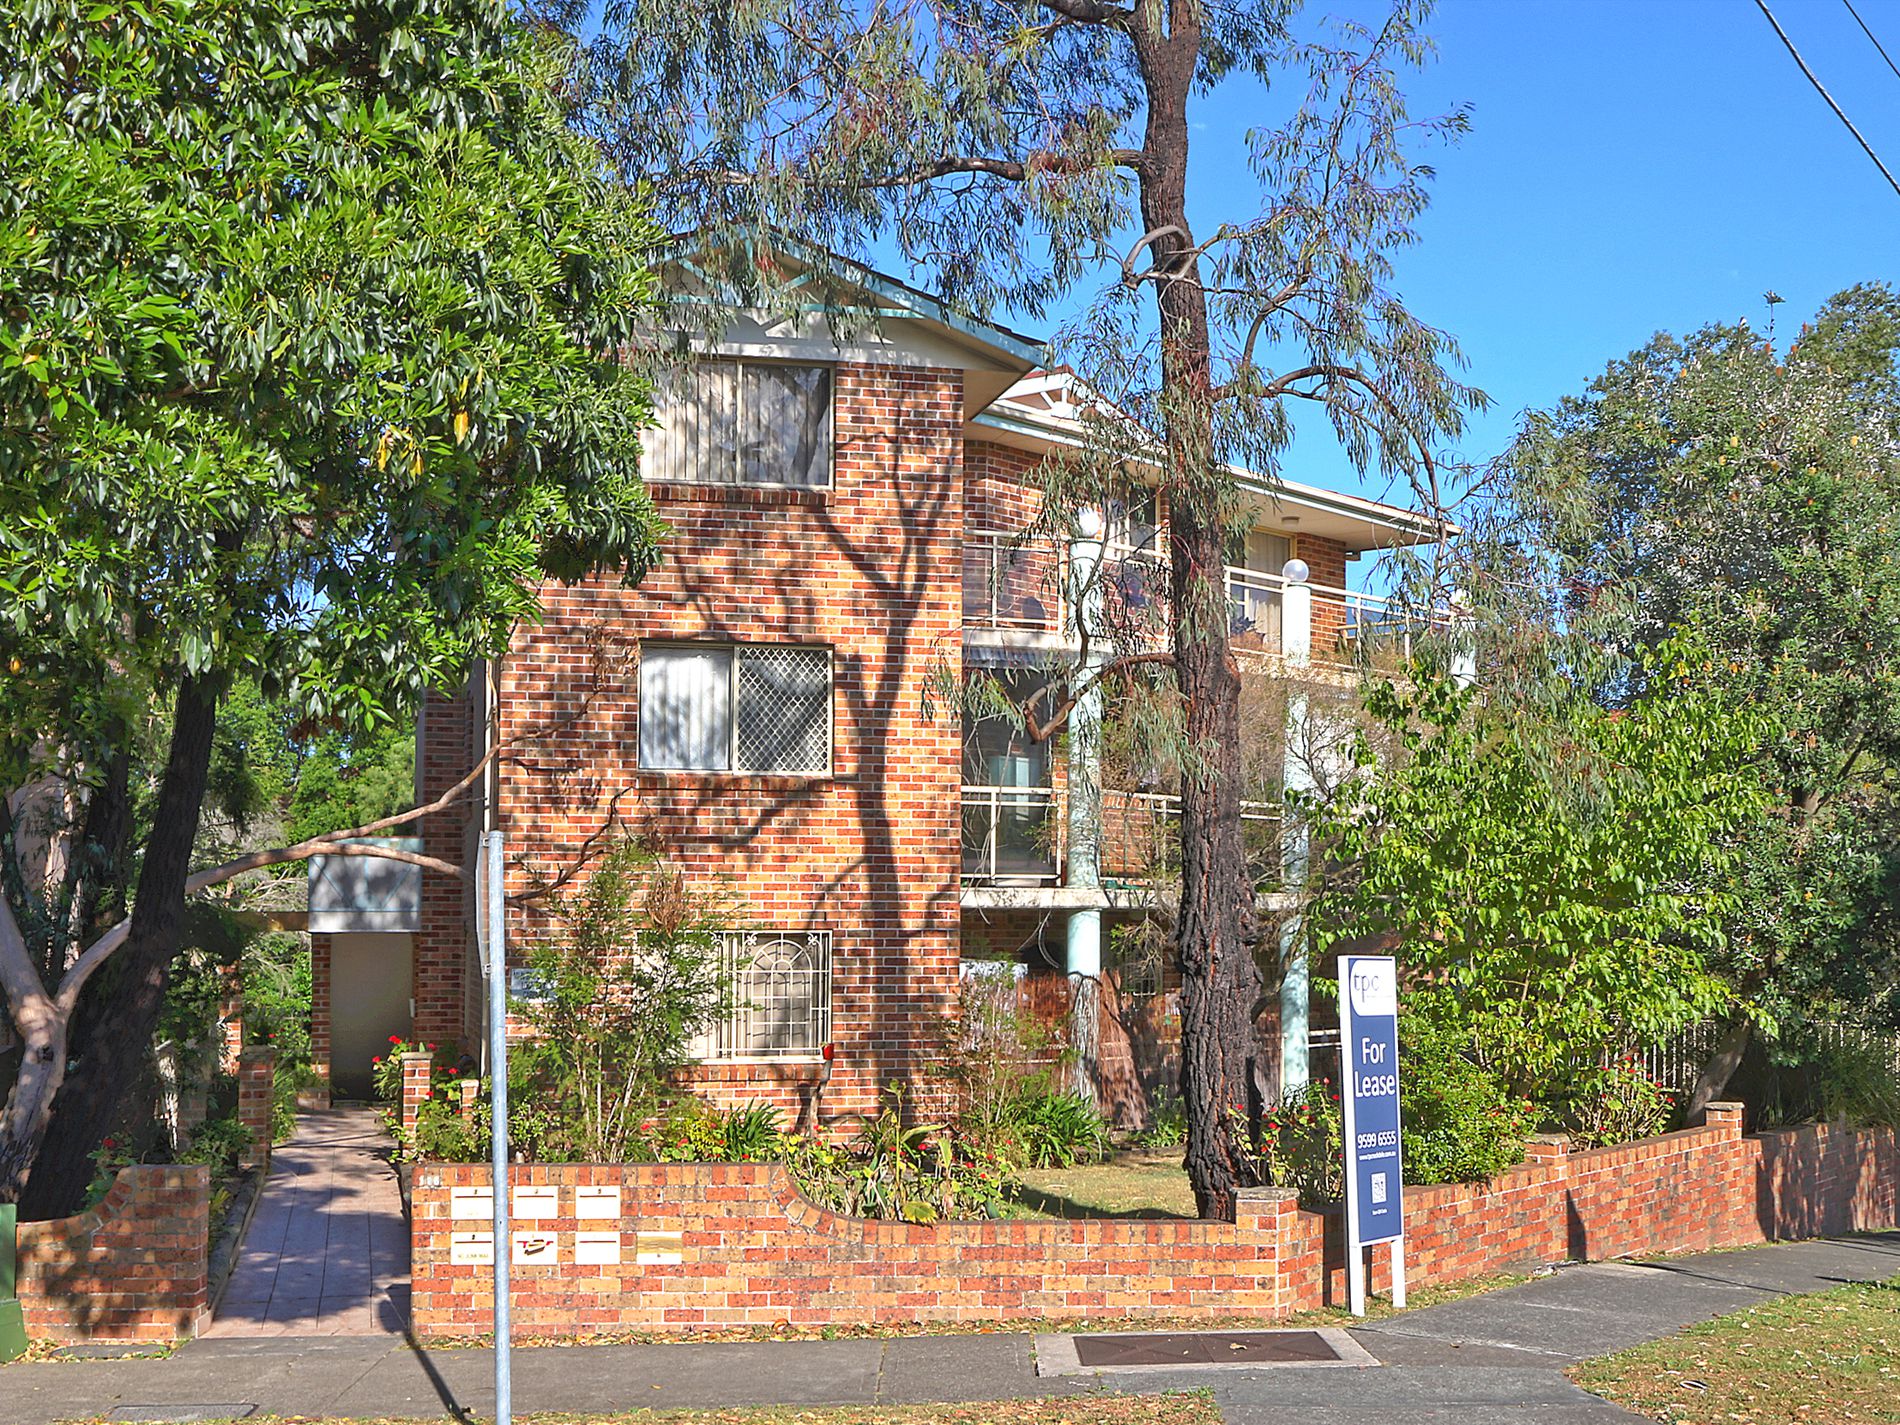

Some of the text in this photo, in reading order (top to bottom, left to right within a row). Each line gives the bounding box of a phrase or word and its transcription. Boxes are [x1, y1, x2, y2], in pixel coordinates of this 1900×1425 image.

[1353, 972, 1379, 1003] tpc
[1361, 1037, 1386, 1065] For
[1354, 1070, 1396, 1098] Lease
[1357, 1130, 1397, 1149] 9599 6555
